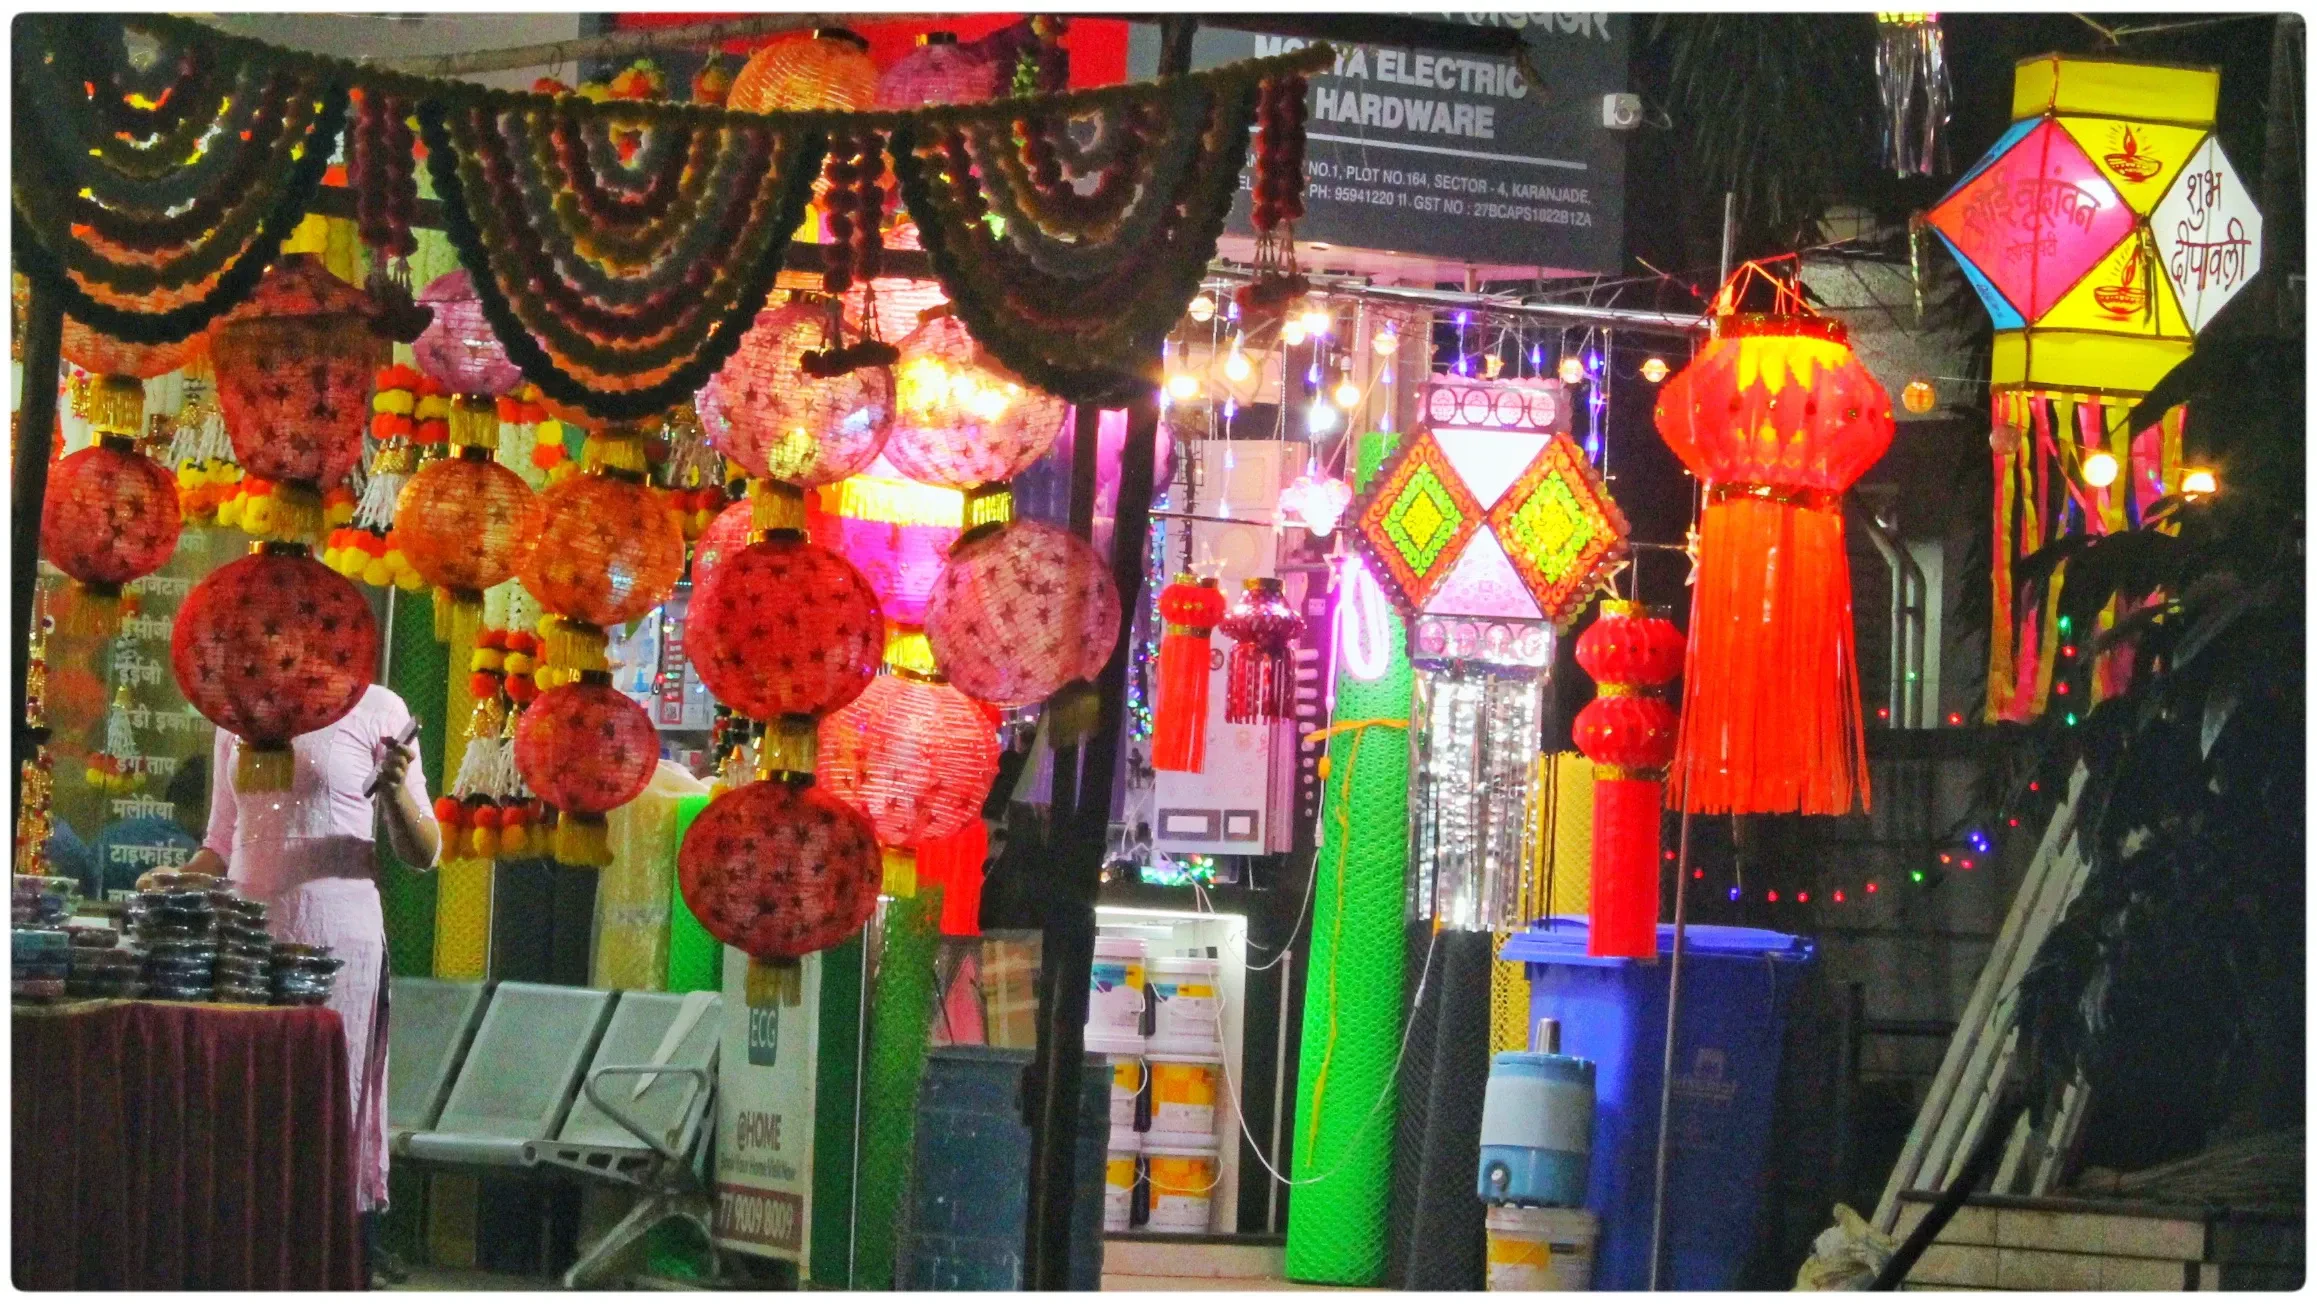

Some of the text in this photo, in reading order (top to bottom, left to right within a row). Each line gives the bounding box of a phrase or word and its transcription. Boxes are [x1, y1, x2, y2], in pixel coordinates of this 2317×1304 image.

[1254, 34, 1528, 99] MYA ELECTRIC
[1315, 87, 1496, 140] HARDWARE
[1308, 161, 1343, 181] NO.1,
[1346, 165, 1380, 183] PLOT
[1383, 170, 1431, 189] NO.164,
[1434, 174, 1488, 194] SECTOR
[1309, 184, 1332, 200] PH:
[1335, 187, 1394, 206] 95941220
[1414, 195, 1442, 213] GST
[2187, 169, 2222, 231] शुभ
[2171, 217, 2252, 296] दीपावली
[111, 793, 175, 820] मलेरिया
[751, 1007, 778, 1048] ECG
[737, 1110, 782, 1151] @HOME
